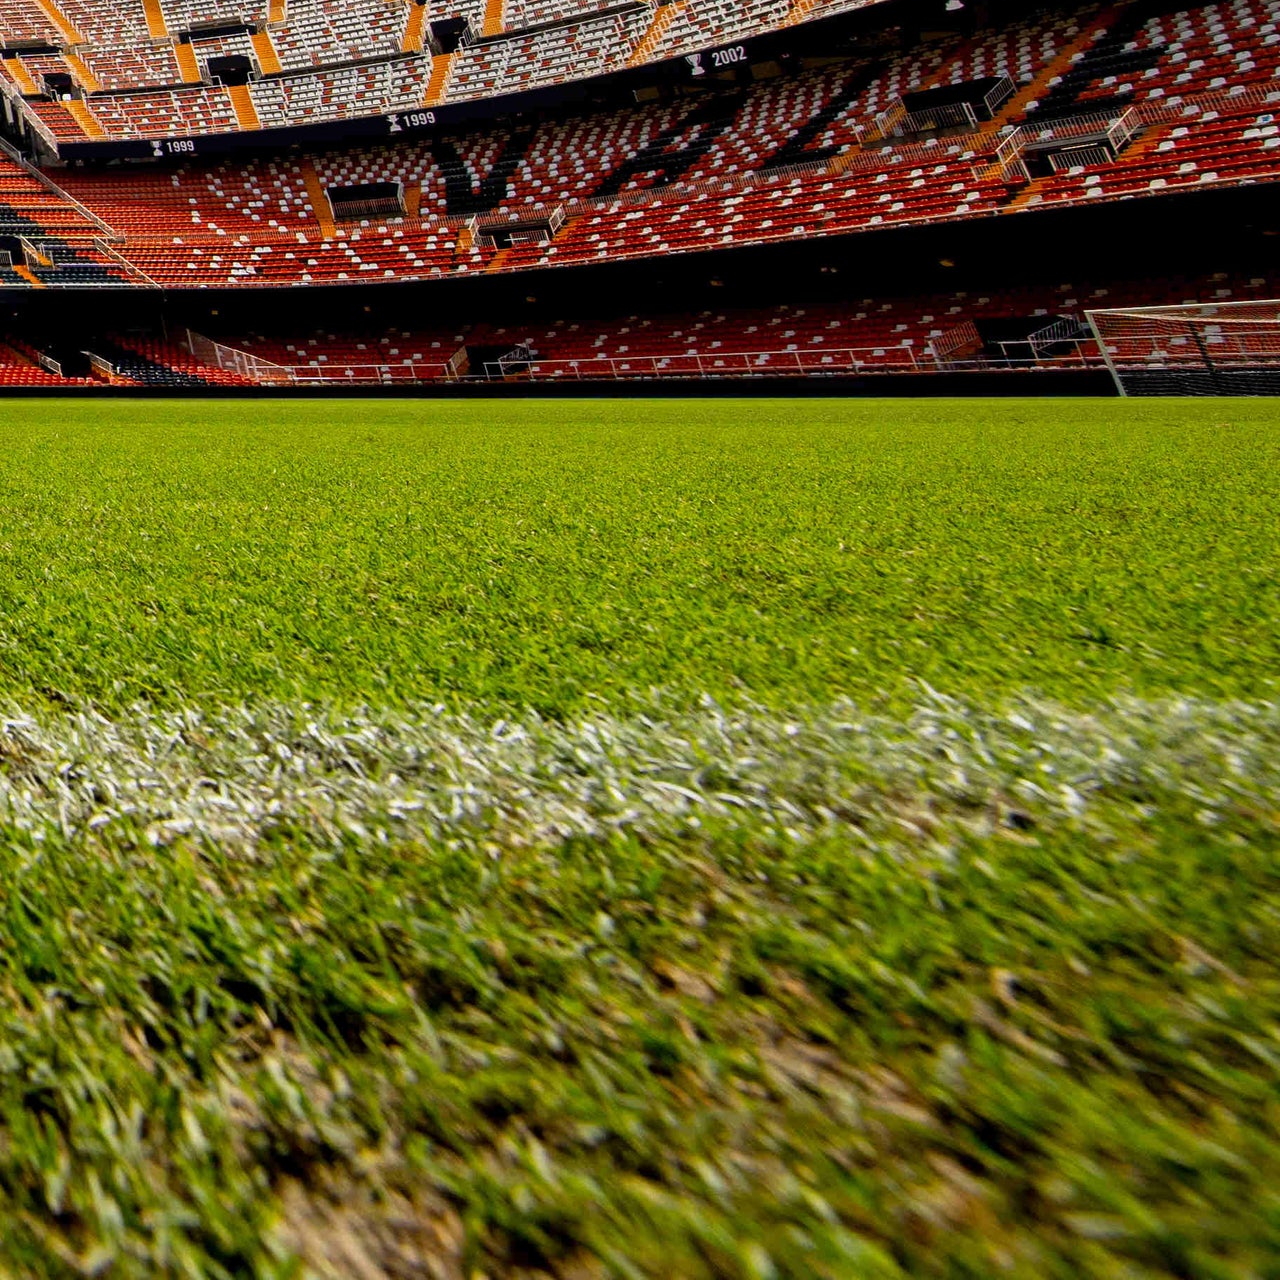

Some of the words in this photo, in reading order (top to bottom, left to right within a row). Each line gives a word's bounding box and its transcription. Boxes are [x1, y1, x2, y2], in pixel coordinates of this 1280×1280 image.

[712, 46, 747, 67] 2002
[403, 111, 435, 128] 1999
[167, 140, 194, 153] 1999
